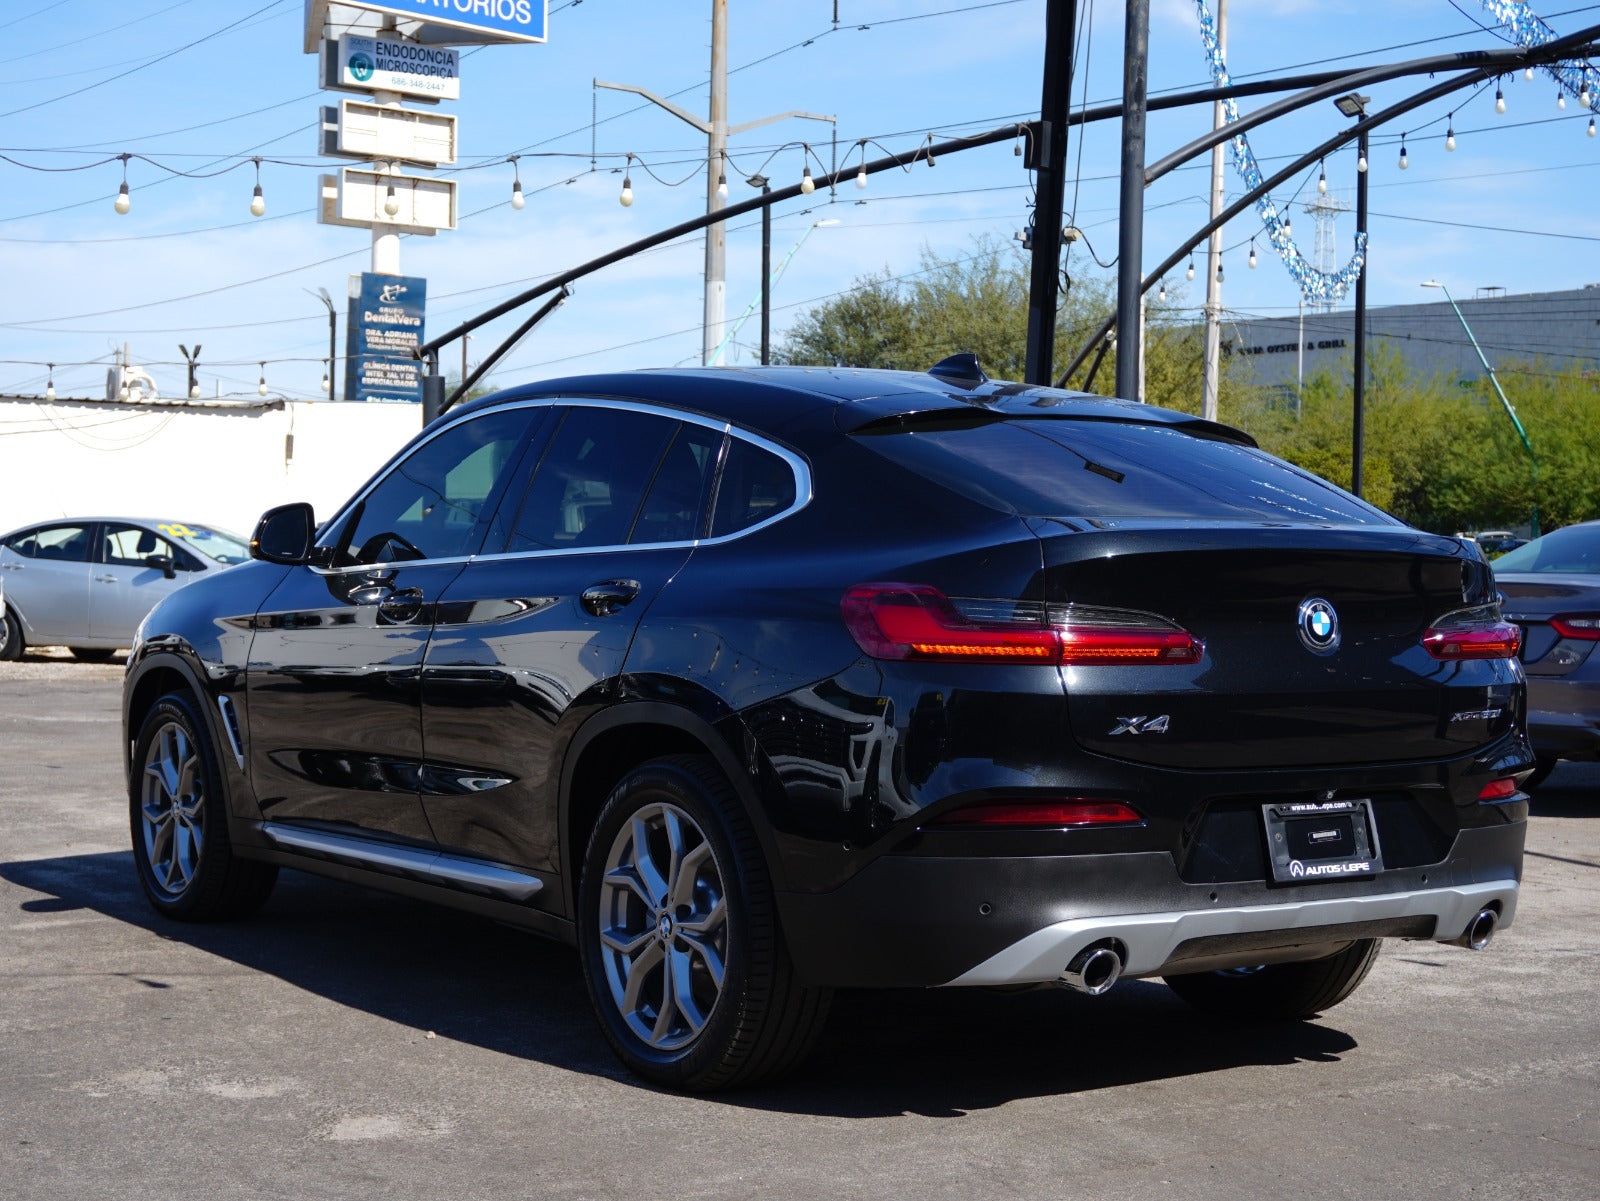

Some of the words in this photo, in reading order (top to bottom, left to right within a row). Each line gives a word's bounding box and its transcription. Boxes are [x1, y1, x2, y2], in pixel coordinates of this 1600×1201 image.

[375, 42, 455, 66] ENDODONCIA
[375, 58, 454, 80] MICROSCOPICA
[1108, 714, 1170, 735] X4
